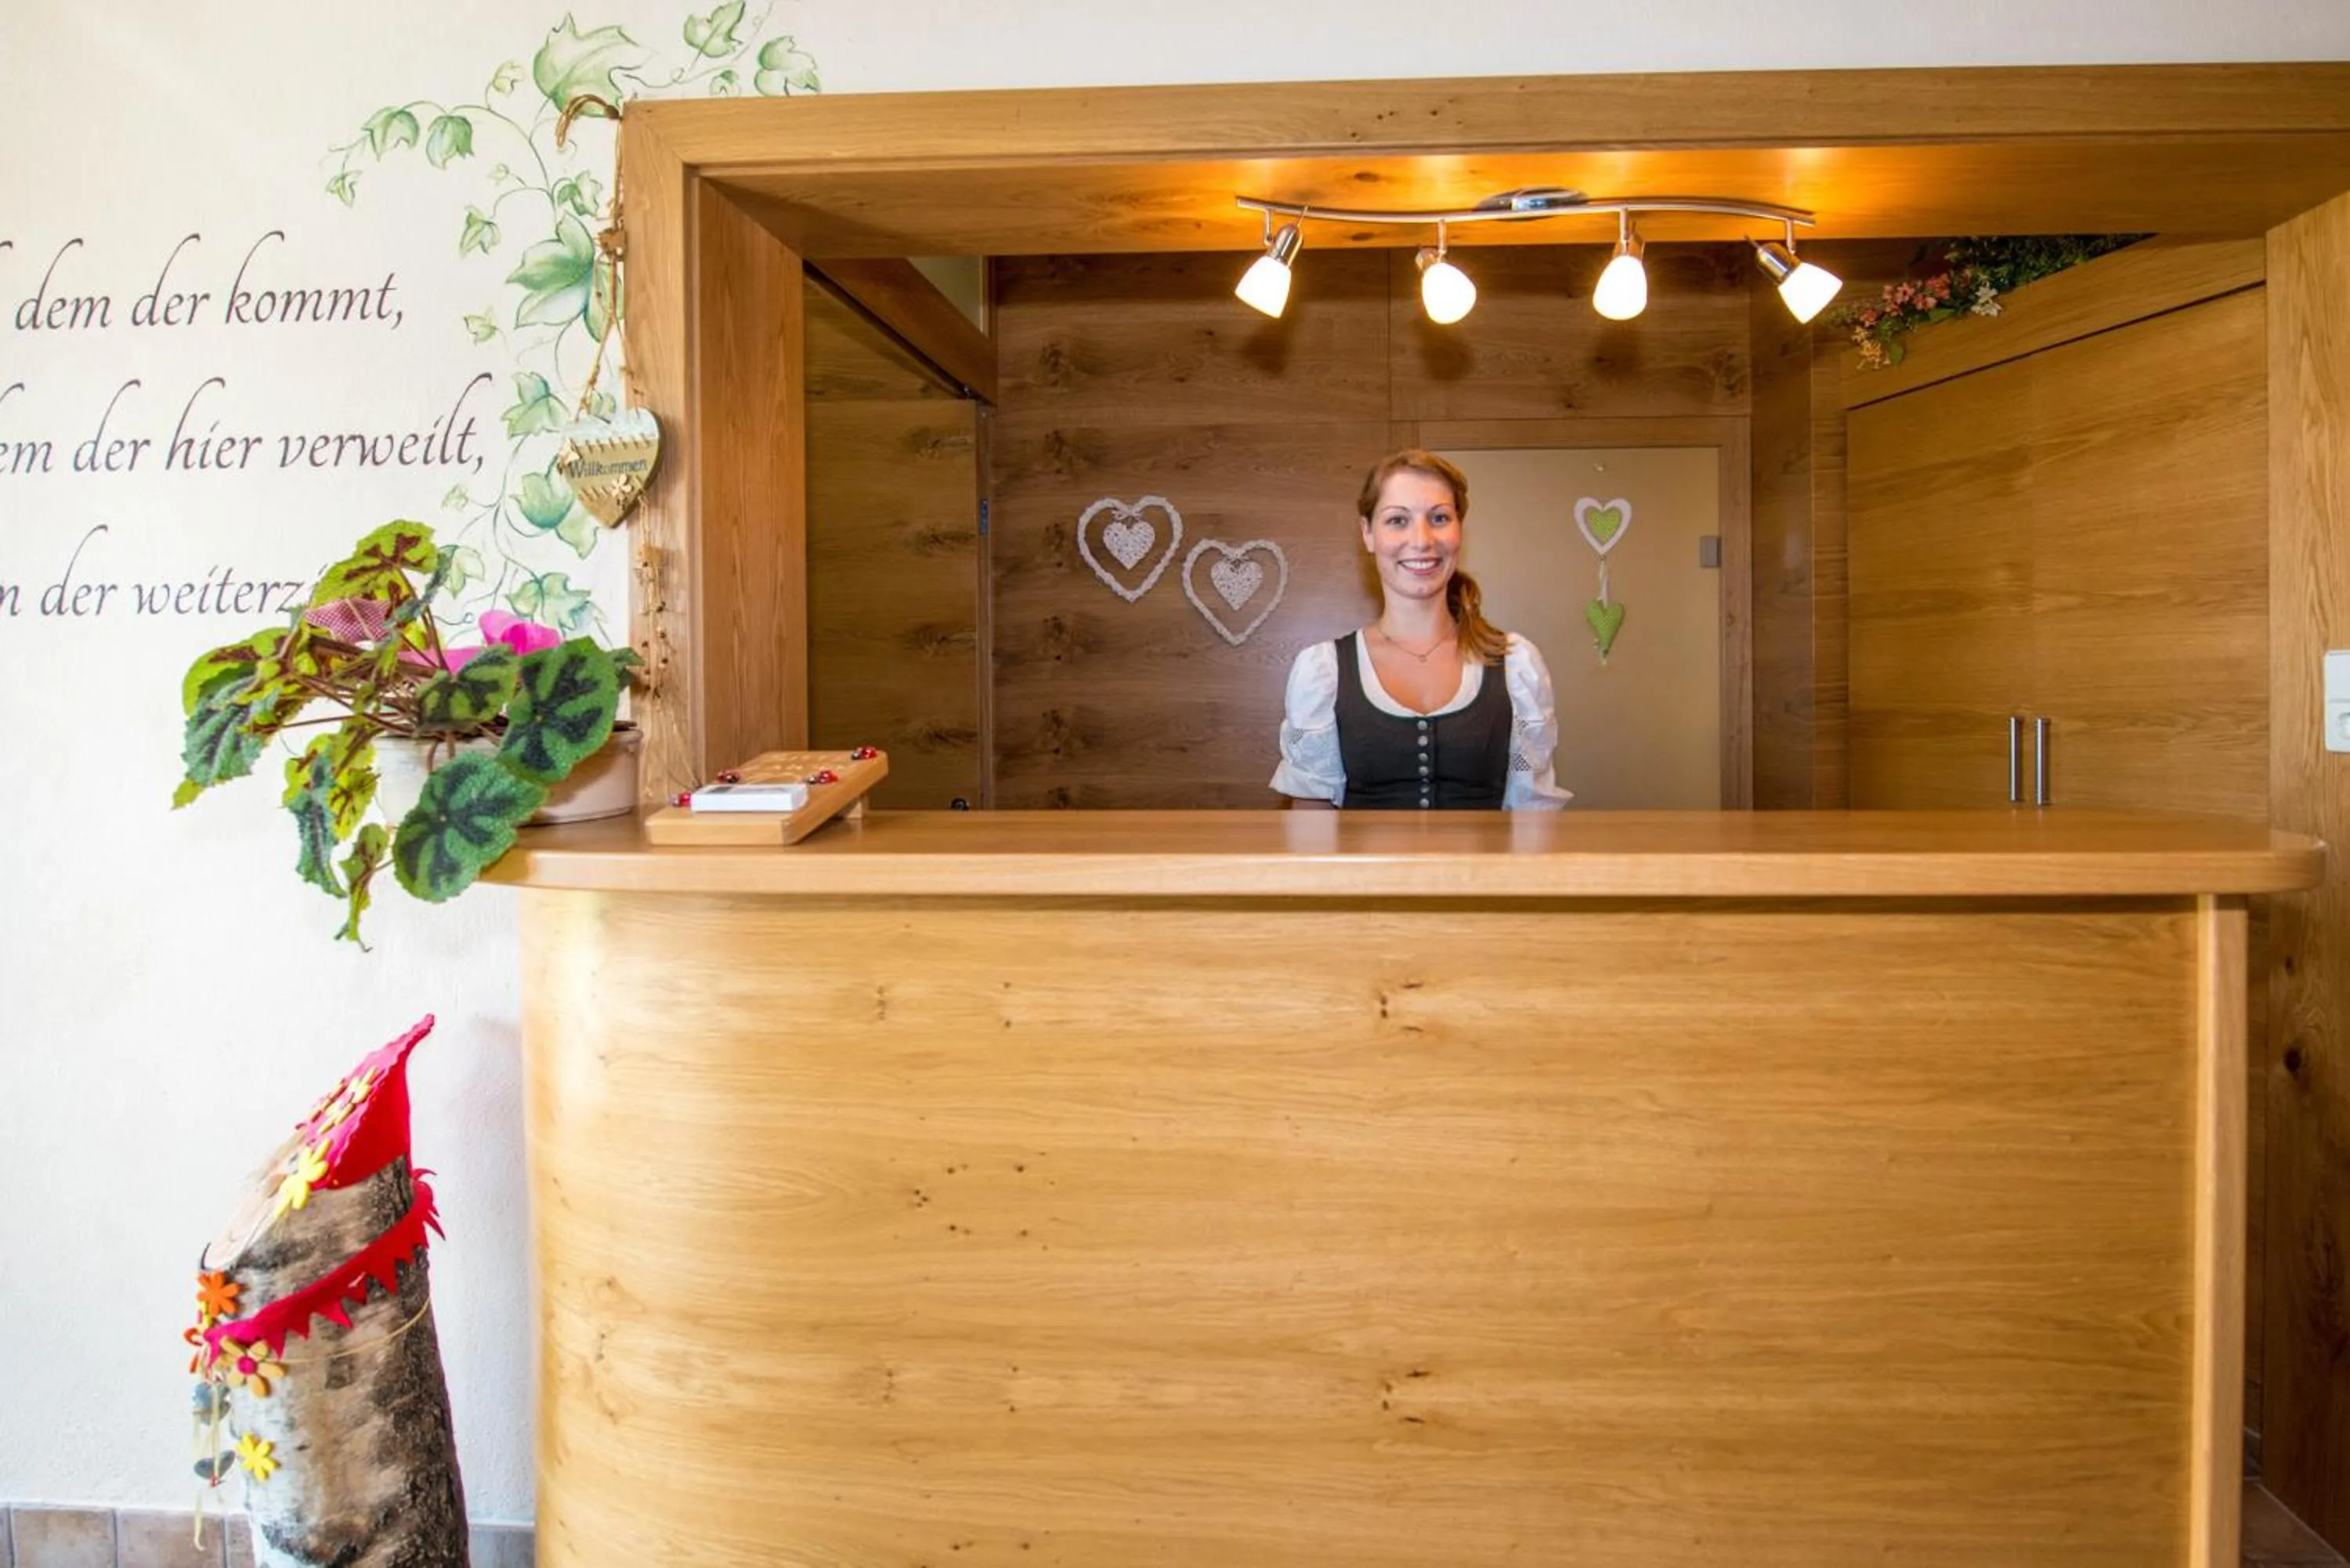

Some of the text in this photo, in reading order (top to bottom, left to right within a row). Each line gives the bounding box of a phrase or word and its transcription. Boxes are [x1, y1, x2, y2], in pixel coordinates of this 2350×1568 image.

[14, 229, 403, 331] dem der kommt,
[73, 378, 151, 473] der
[164, 376, 264, 471] hier
[277, 371, 494, 475] verweilt,
[40, 523, 119, 617] der
